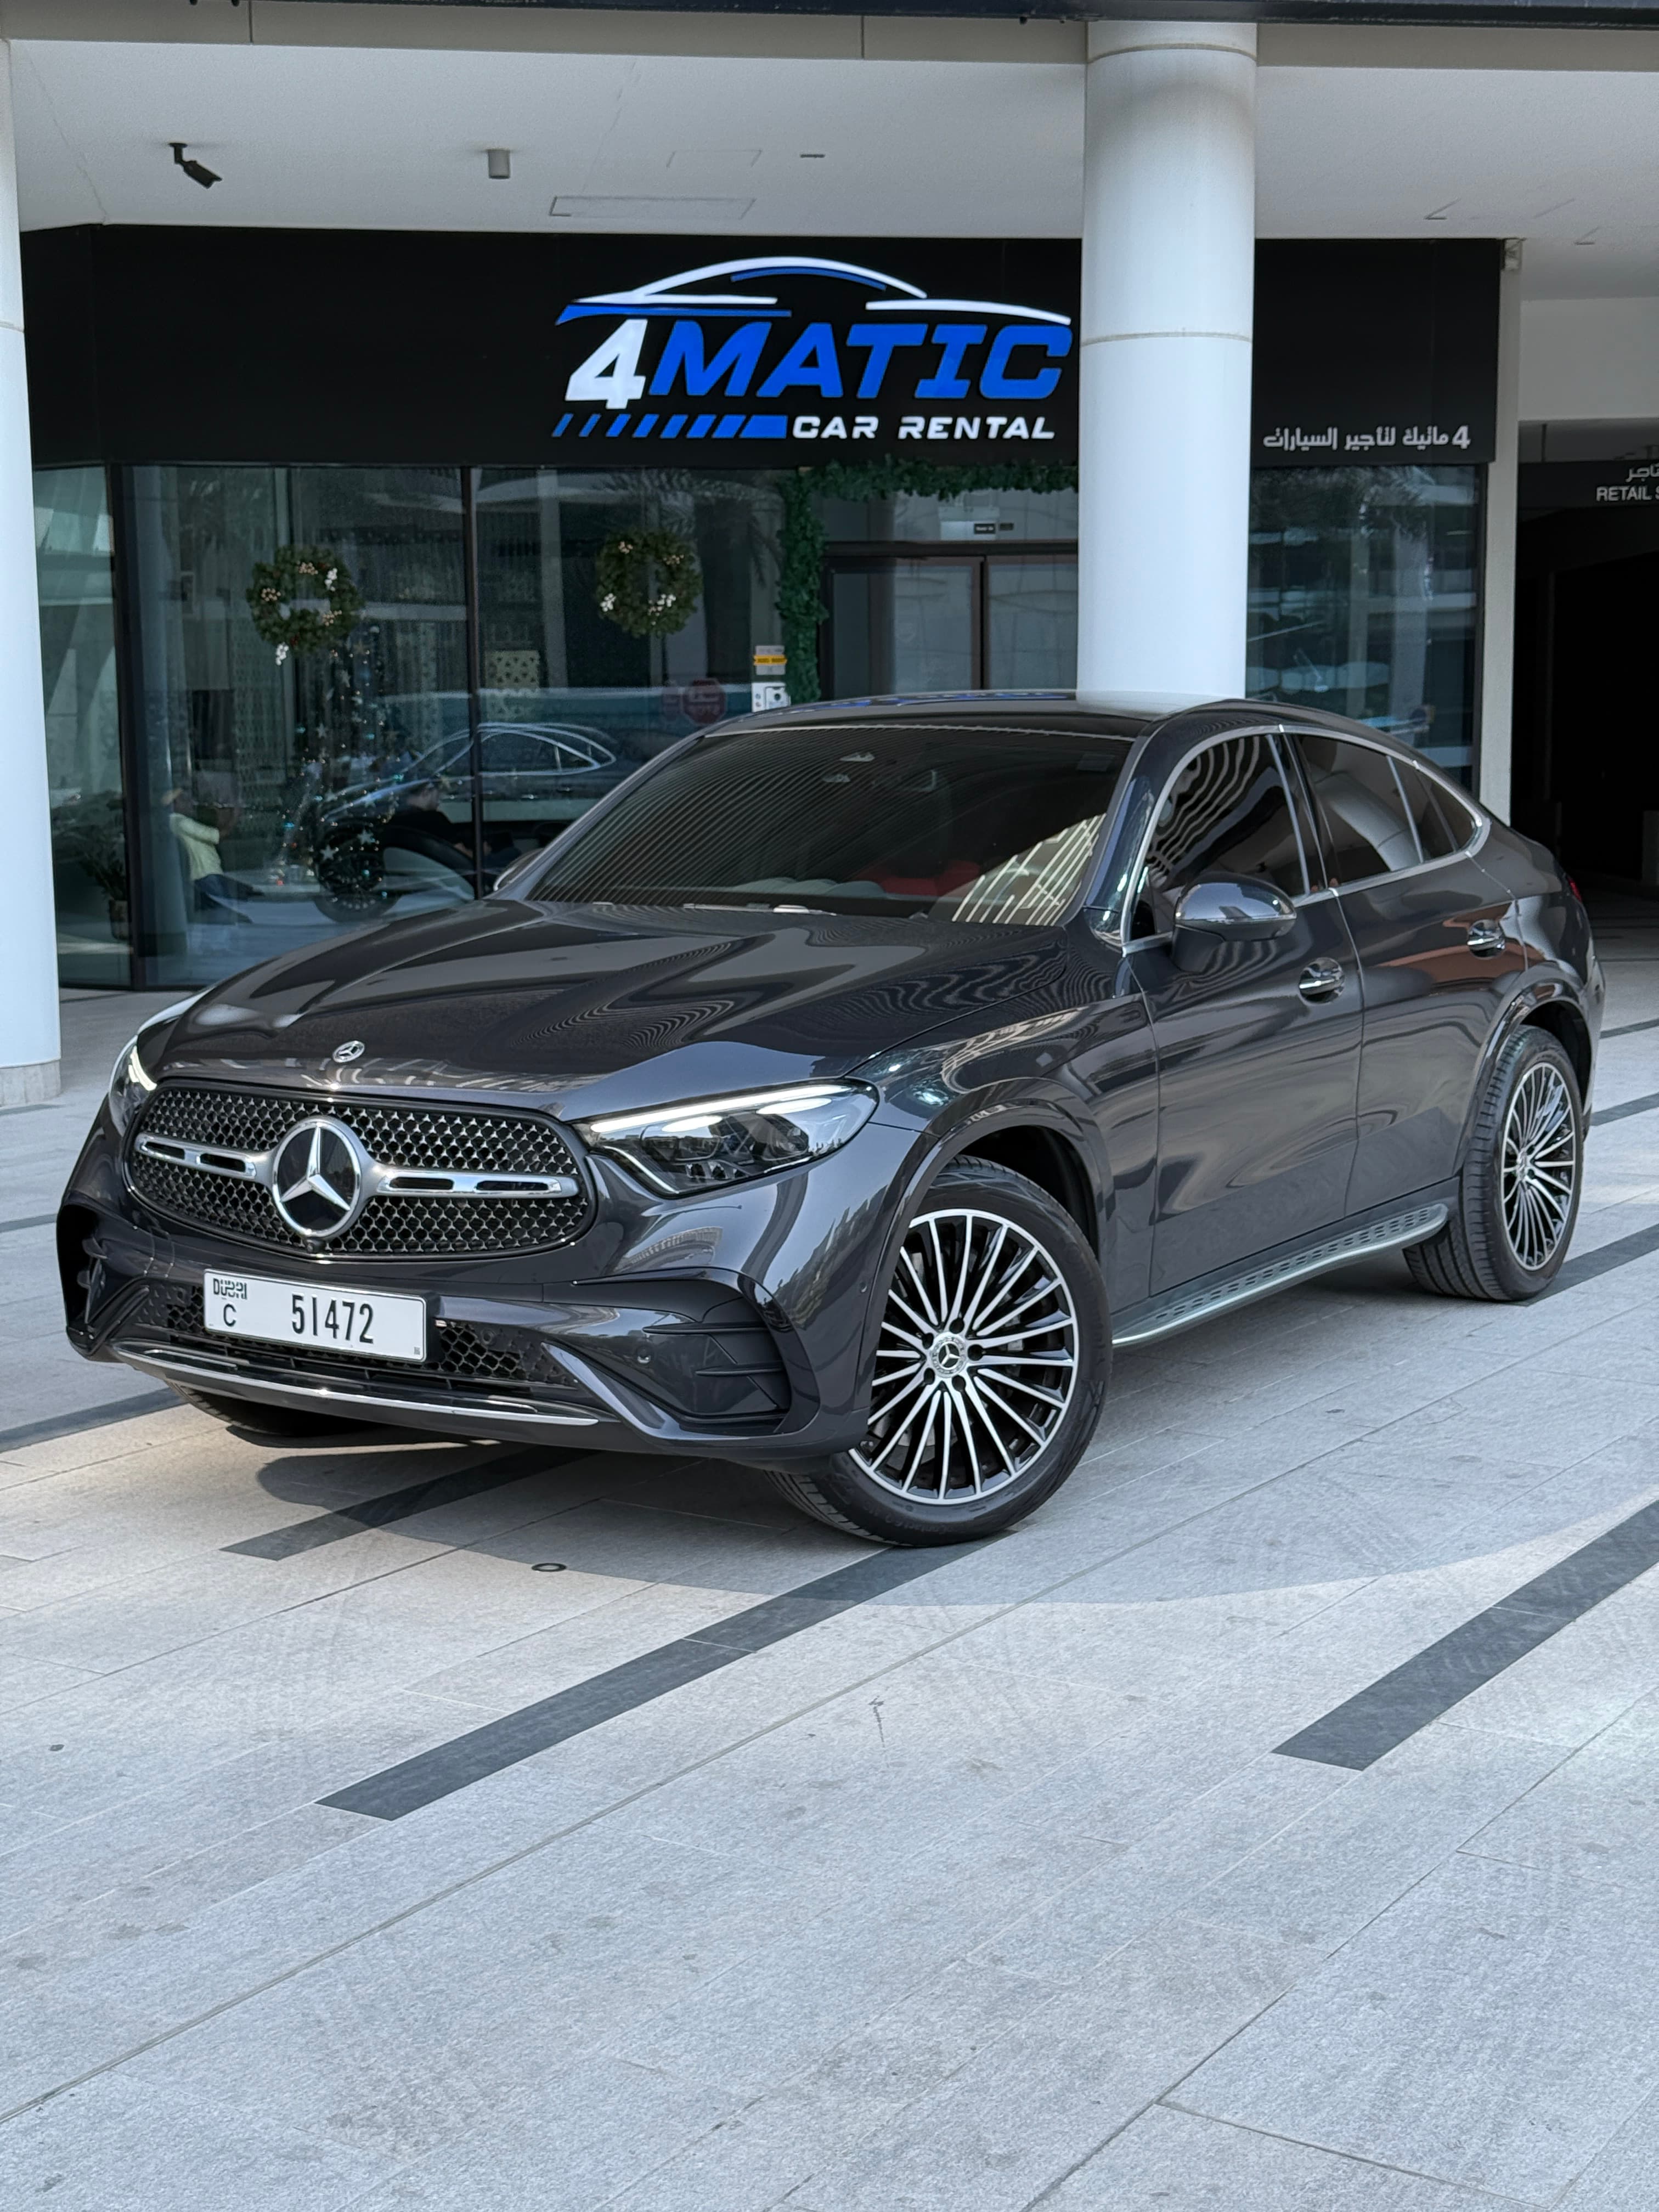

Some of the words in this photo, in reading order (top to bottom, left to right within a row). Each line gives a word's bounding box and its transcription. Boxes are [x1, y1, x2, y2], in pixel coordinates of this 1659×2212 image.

[565, 318, 1073, 409] 4MATIC
[793, 416, 879, 439] CAR
[898, 416, 1054, 439] RENTAL
[1263, 427, 1338, 451] السيارات
[1344, 426, 1396, 450] لتأجير
[1596, 486, 1652, 501] RETAIL
[223, 1304, 236, 1327] C
[291, 1293, 374, 1345] 51472
